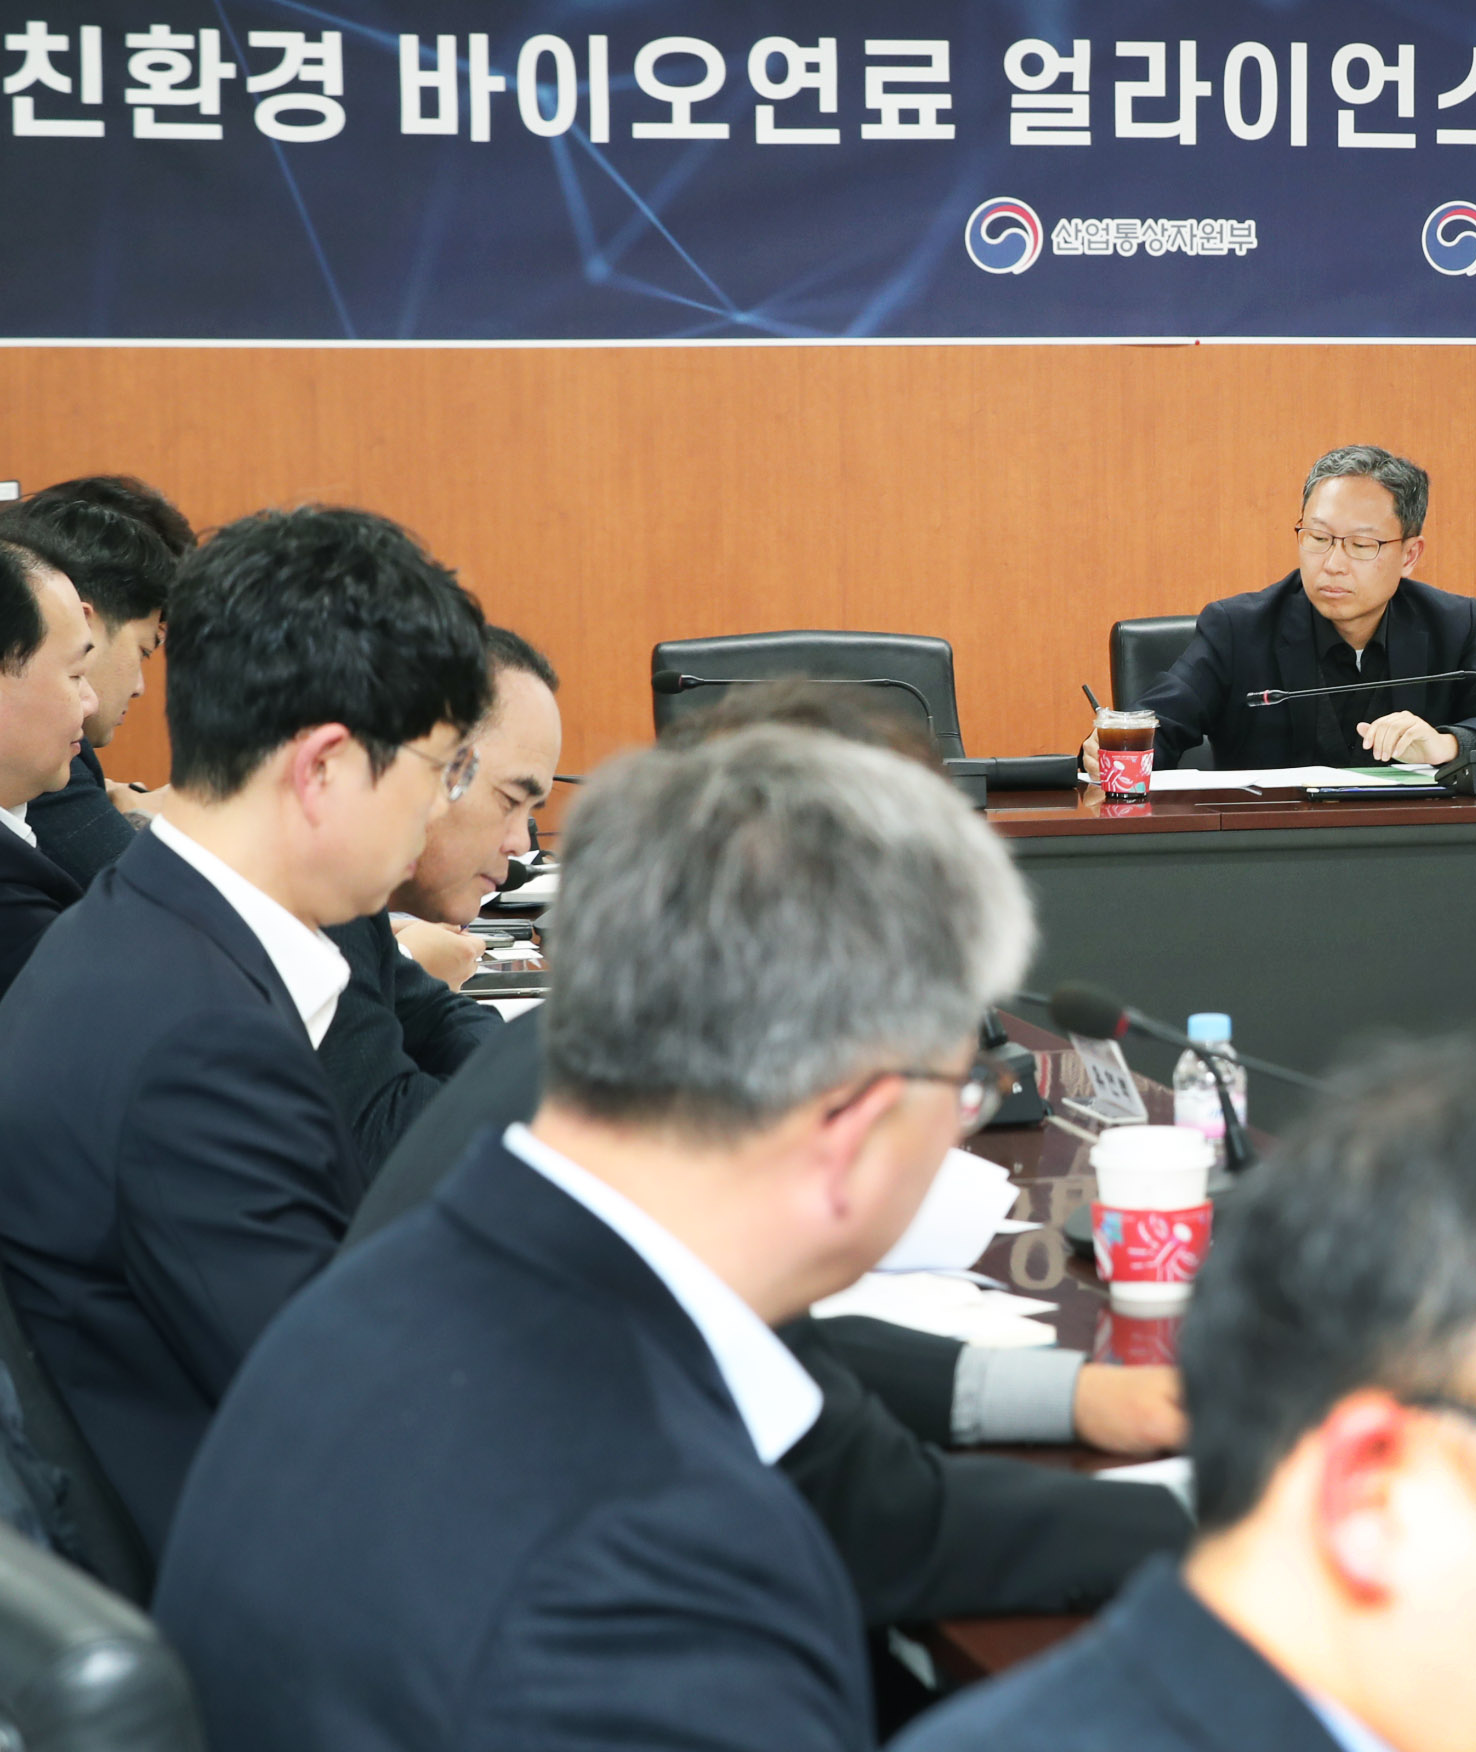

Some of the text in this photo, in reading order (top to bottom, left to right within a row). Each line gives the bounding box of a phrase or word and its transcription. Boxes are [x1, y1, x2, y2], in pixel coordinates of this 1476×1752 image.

[4, 21, 345, 142] 친환경
[399, 34, 955, 144] 바이오연료
[1051, 218, 1257, 257] 산업통상자원부
